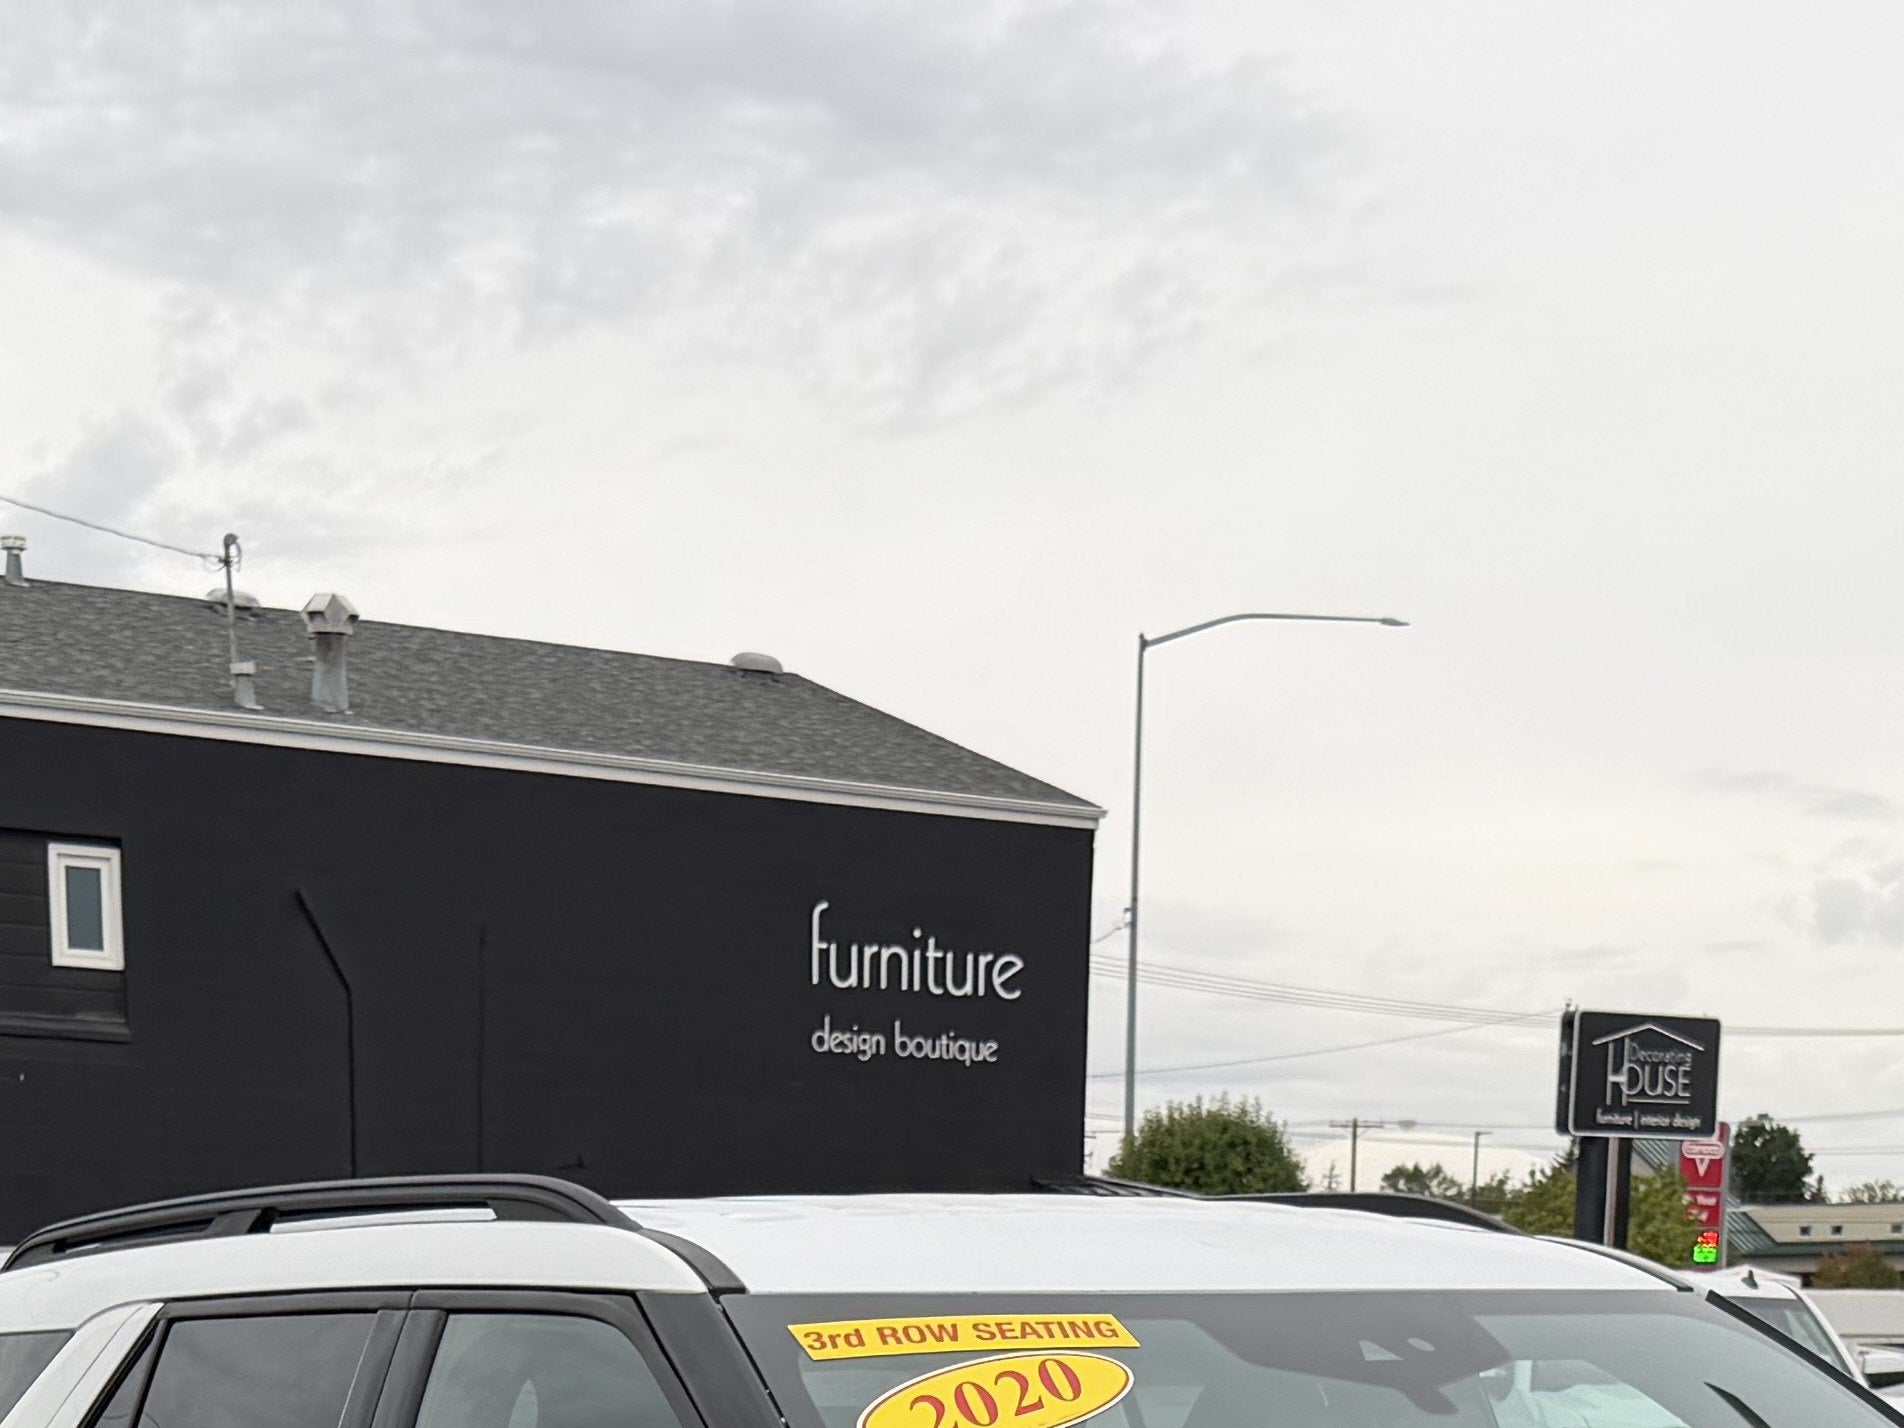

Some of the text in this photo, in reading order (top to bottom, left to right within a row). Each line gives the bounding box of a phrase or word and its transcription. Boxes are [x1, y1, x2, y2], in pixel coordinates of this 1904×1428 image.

[809, 900, 1024, 1000] furniture
[811, 1014, 999, 1067] design boutique
[803, 1320, 1119, 1352] 3rd ROW SEATING
